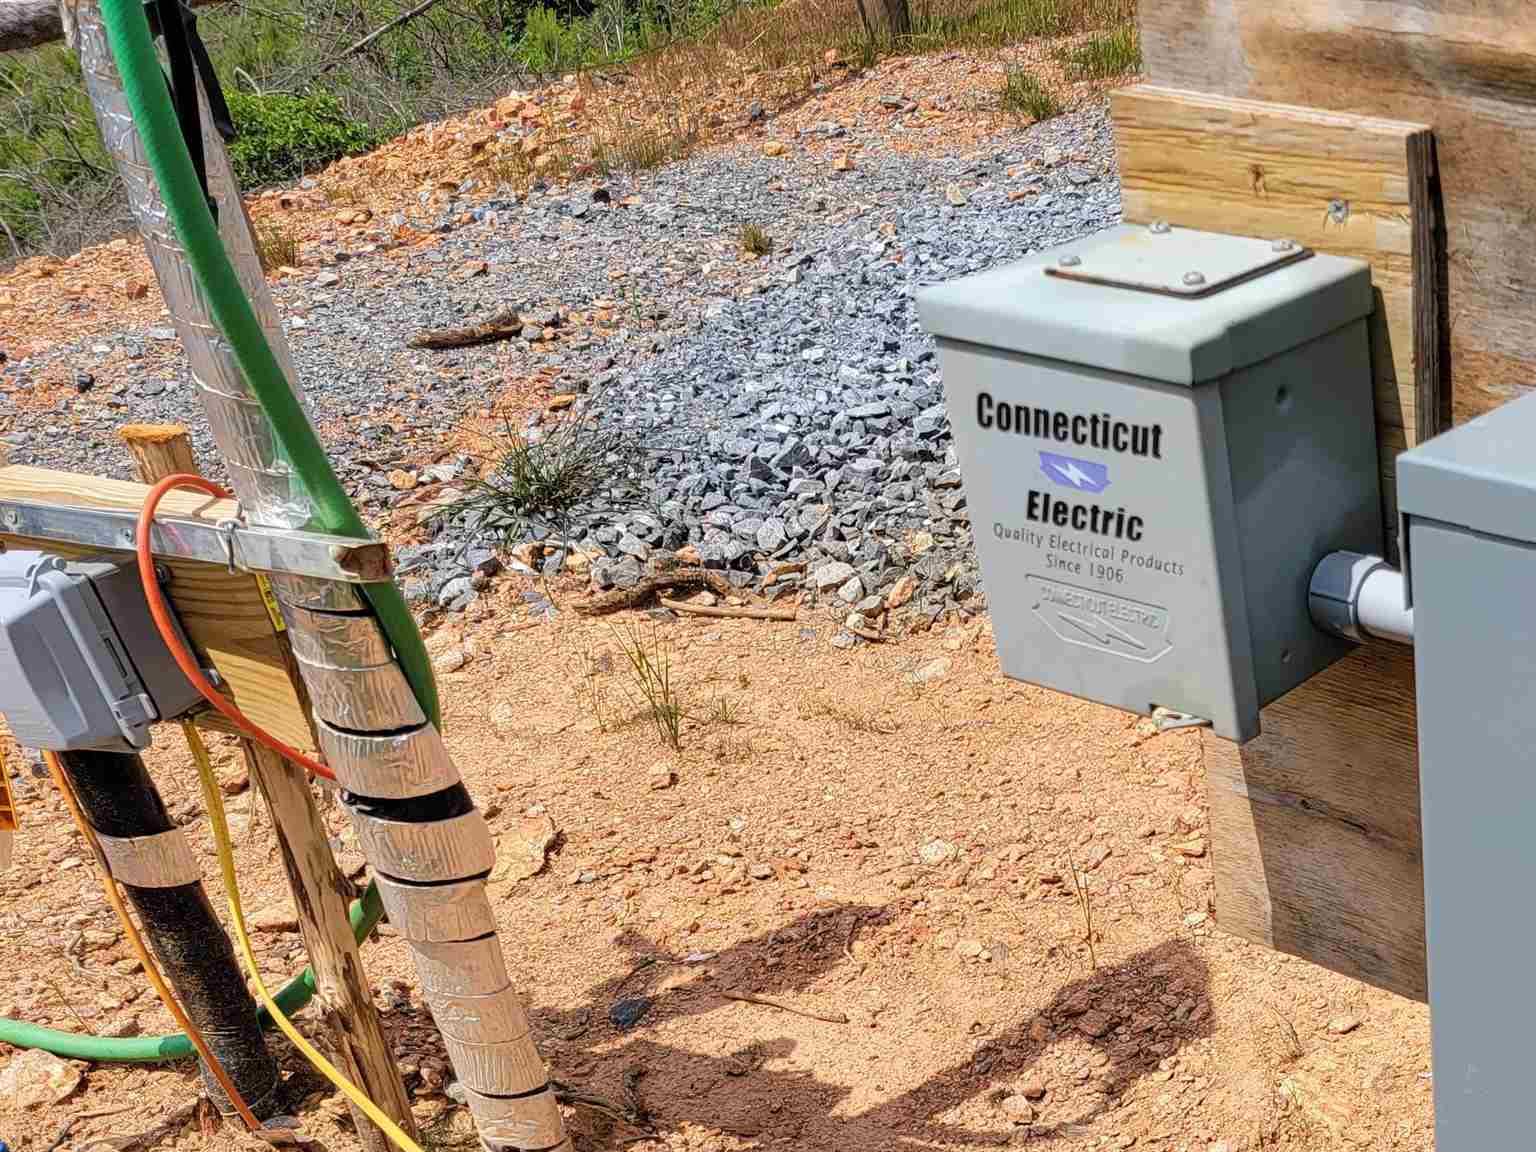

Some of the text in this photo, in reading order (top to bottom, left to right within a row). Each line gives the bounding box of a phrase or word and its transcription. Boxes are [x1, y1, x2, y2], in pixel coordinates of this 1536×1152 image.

[976, 392, 1163, 460] Connecticut
[1026, 489, 1144, 542] Electric
[992, 522, 1185, 577] Quality Electrical Products
[1045, 553, 1124, 584] Since 1906
